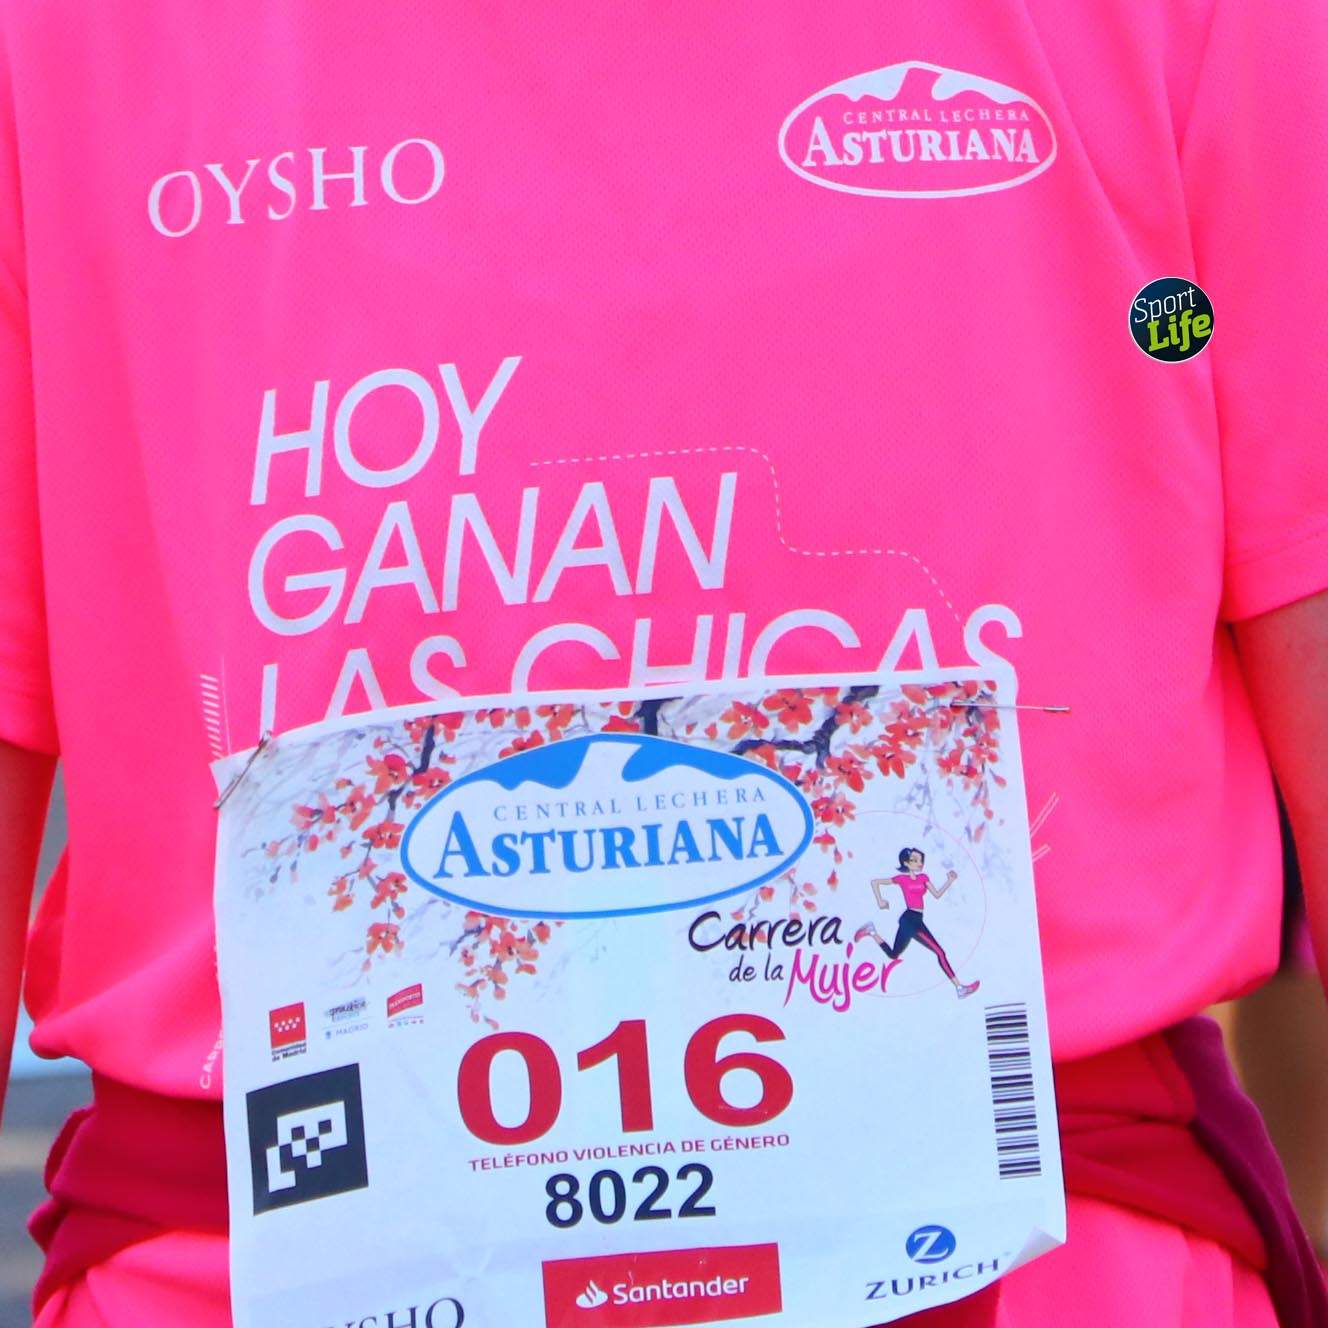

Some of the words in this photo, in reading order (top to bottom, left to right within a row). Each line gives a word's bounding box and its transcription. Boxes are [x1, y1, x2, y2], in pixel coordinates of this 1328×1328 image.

[801, 115, 1040, 167] ASTURIANA
[843, 109, 932, 125] CENTRAL
[940, 108, 1030, 123] LECHERA
[147, 137, 446, 239] OYSHO
[1134, 286, 1197, 324] Sport
[1147, 309, 1212, 353] Life
[249, 355, 524, 506] HOY
[248, 472, 738, 636] GANAN
[493, 798, 622, 822] CENTRAL
[636, 786, 768, 812] LECHERA
[432, 810, 785, 879] ASTURIANA
[688, 910, 844, 953] Carrera
[728, 954, 757, 983] de
[764, 952, 785, 982] la
[783, 941, 904, 1013] Mujer
[457, 1012, 795, 1146] 016
[468, 1149, 569, 1172] TELÉFONO
[573, 1139, 677, 1162] VIOLENCIA
[681, 1139, 706, 1154] DE
[710, 1133, 791, 1152] GÉNERO
[544, 1162, 717, 1229] 8022
[612, 1275, 750, 1305] Santander
[864, 1256, 1002, 1302] ZURICH
